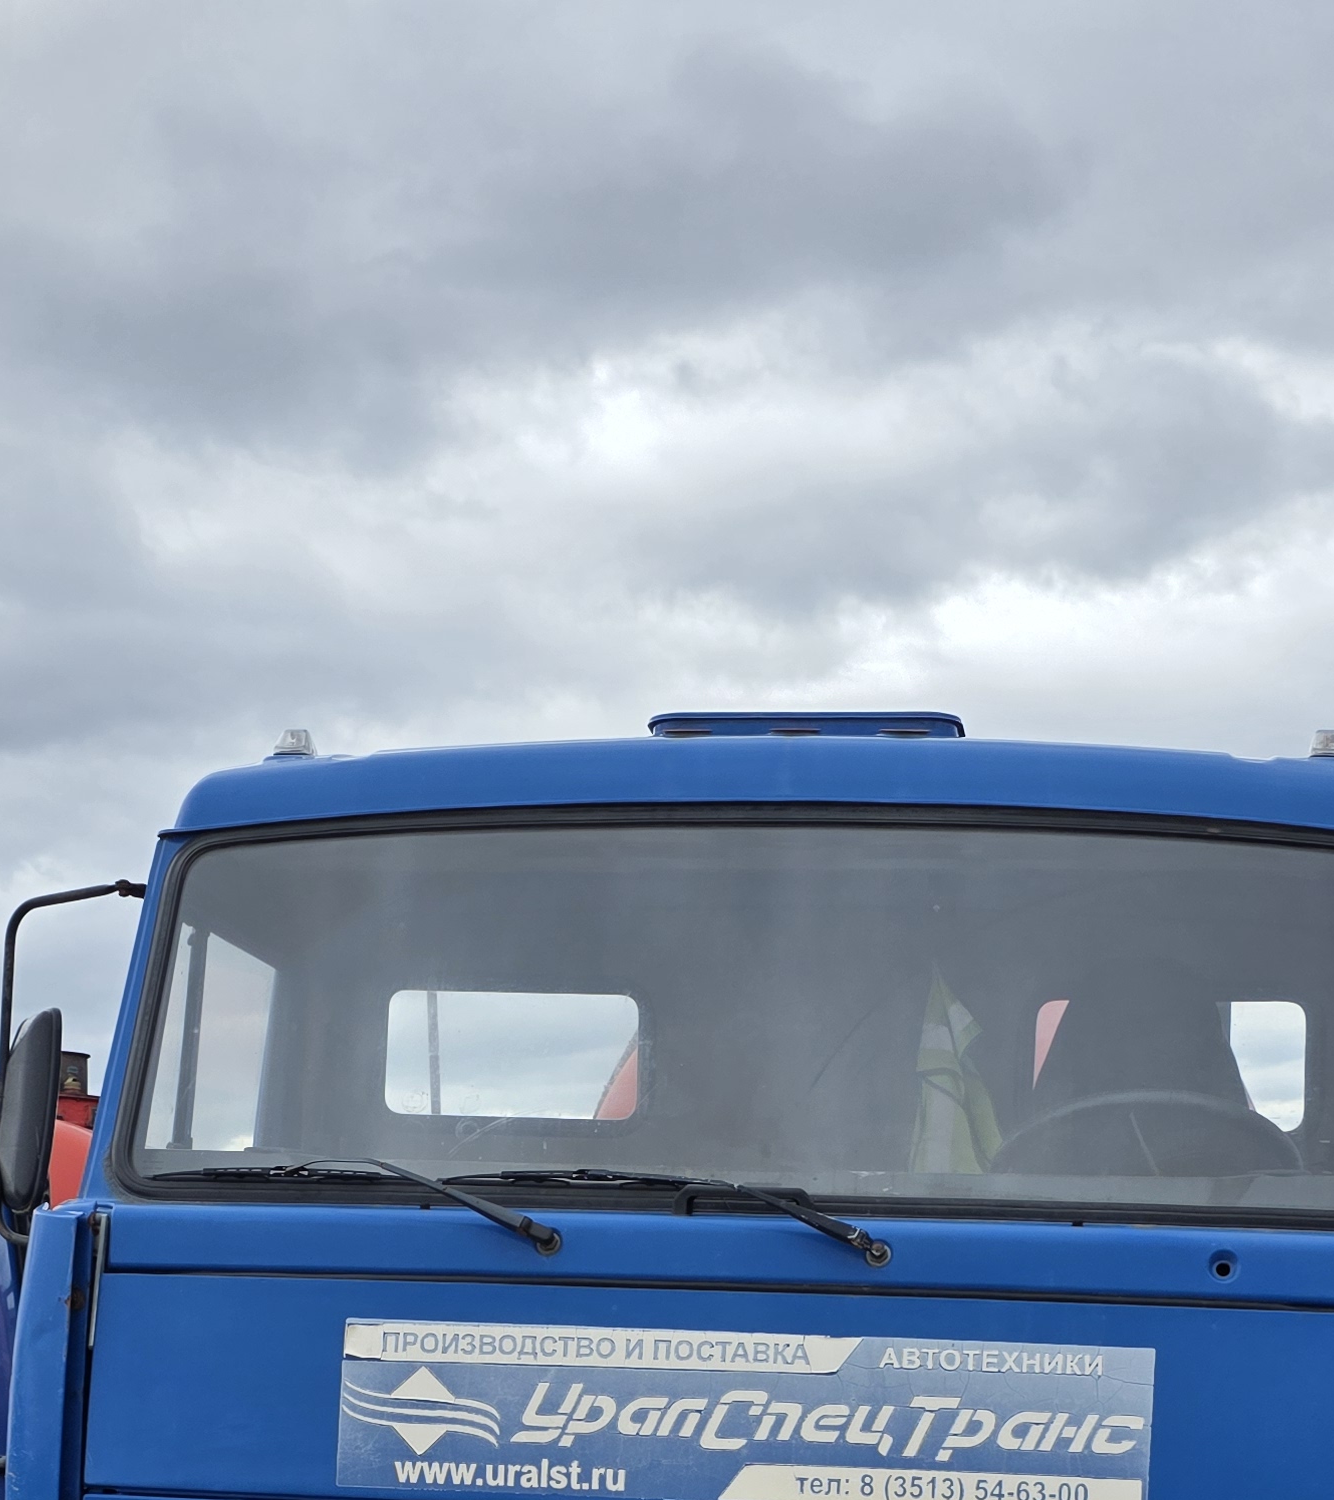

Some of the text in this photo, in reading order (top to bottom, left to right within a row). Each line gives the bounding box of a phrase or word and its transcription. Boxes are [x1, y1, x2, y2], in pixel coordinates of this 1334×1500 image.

[382, 1332, 810, 1366] ПРОИЗВОДСТВО И ПОСТАВКА
[879, 1347, 1104, 1376] АВТОТЕХНИКИ
[395, 1459, 627, 1492] www.uralst.ru
[796, 1475, 852, 1497] тел:
[860, 1474, 874, 1496] 8
